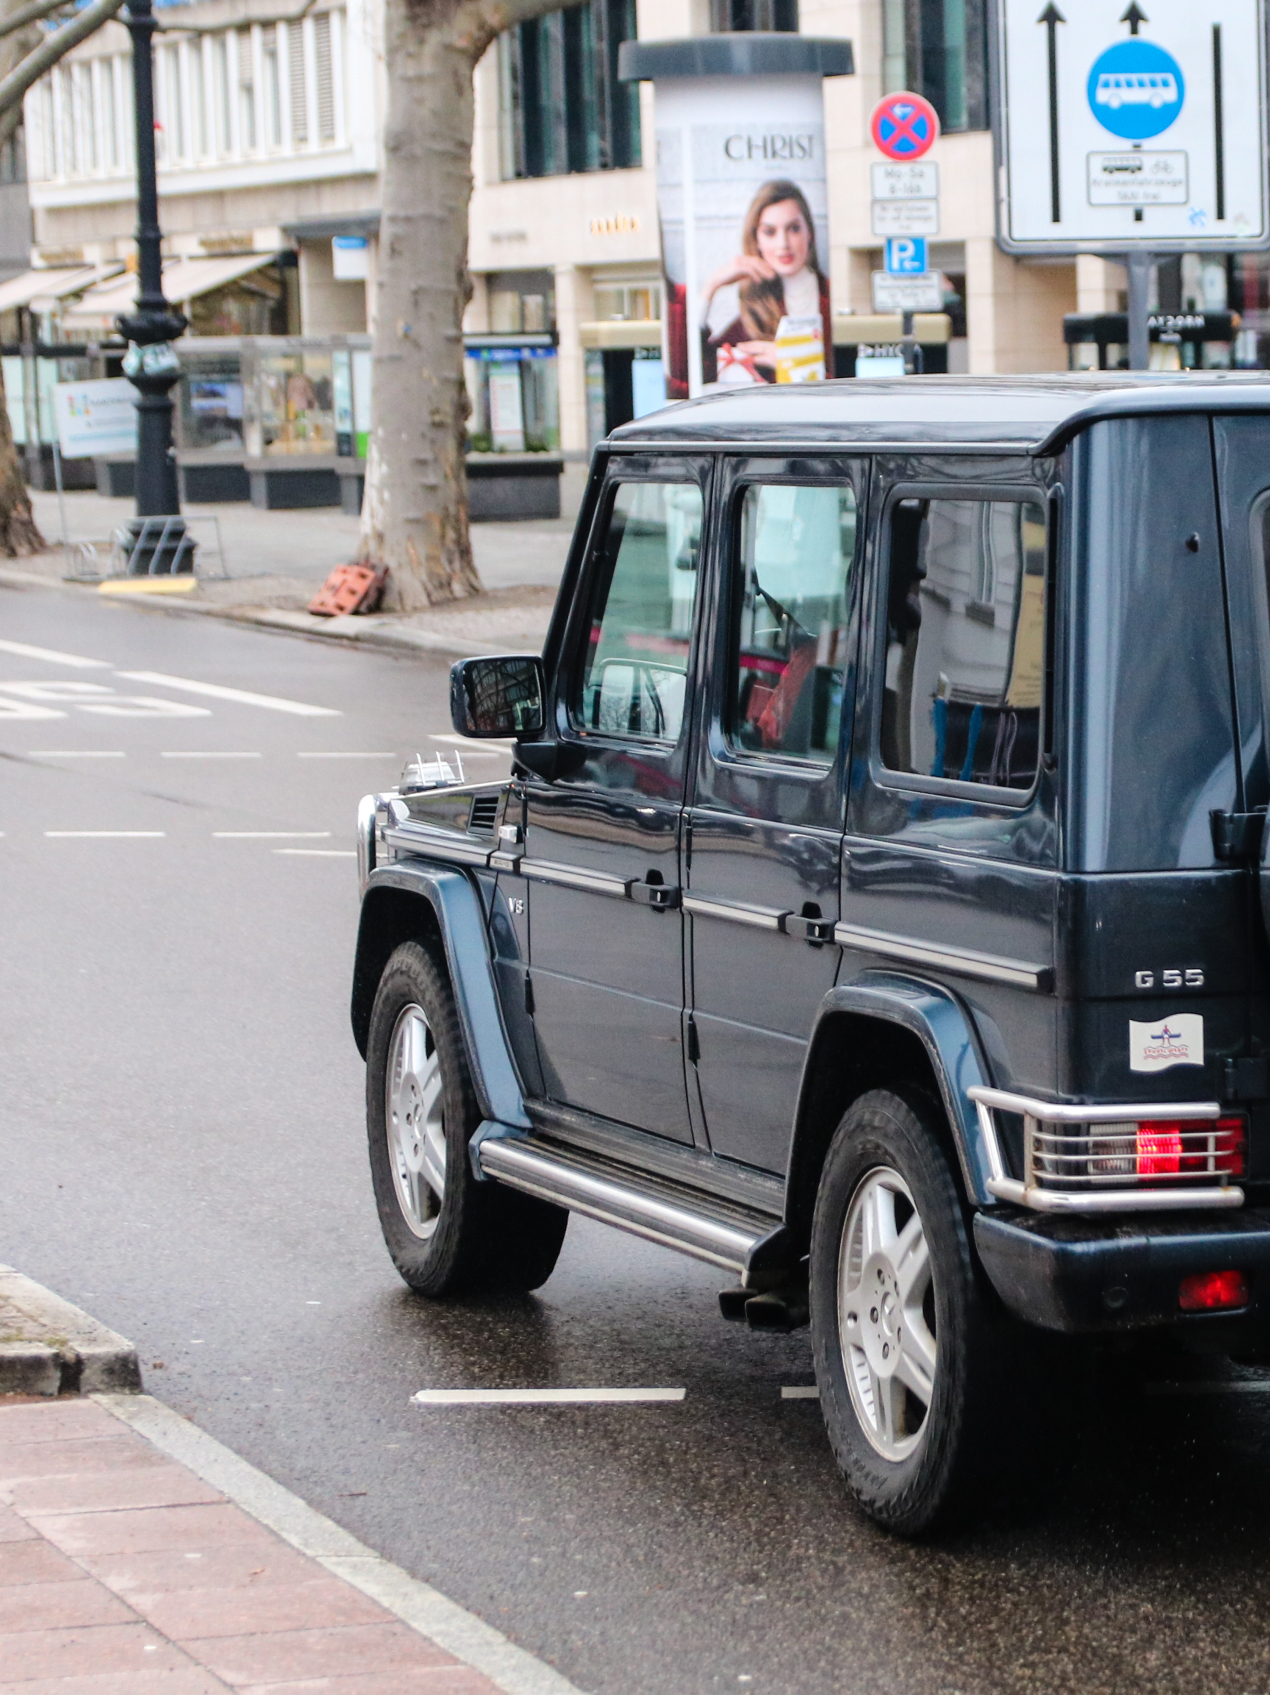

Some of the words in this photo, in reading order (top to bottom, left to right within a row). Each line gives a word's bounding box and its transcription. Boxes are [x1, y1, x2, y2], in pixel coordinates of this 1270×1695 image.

[724, 134, 814, 160] CHRIST
[891, 238, 916, 270] P
[1135, 970, 1154, 988] G
[1163, 969, 1205, 987] 55
